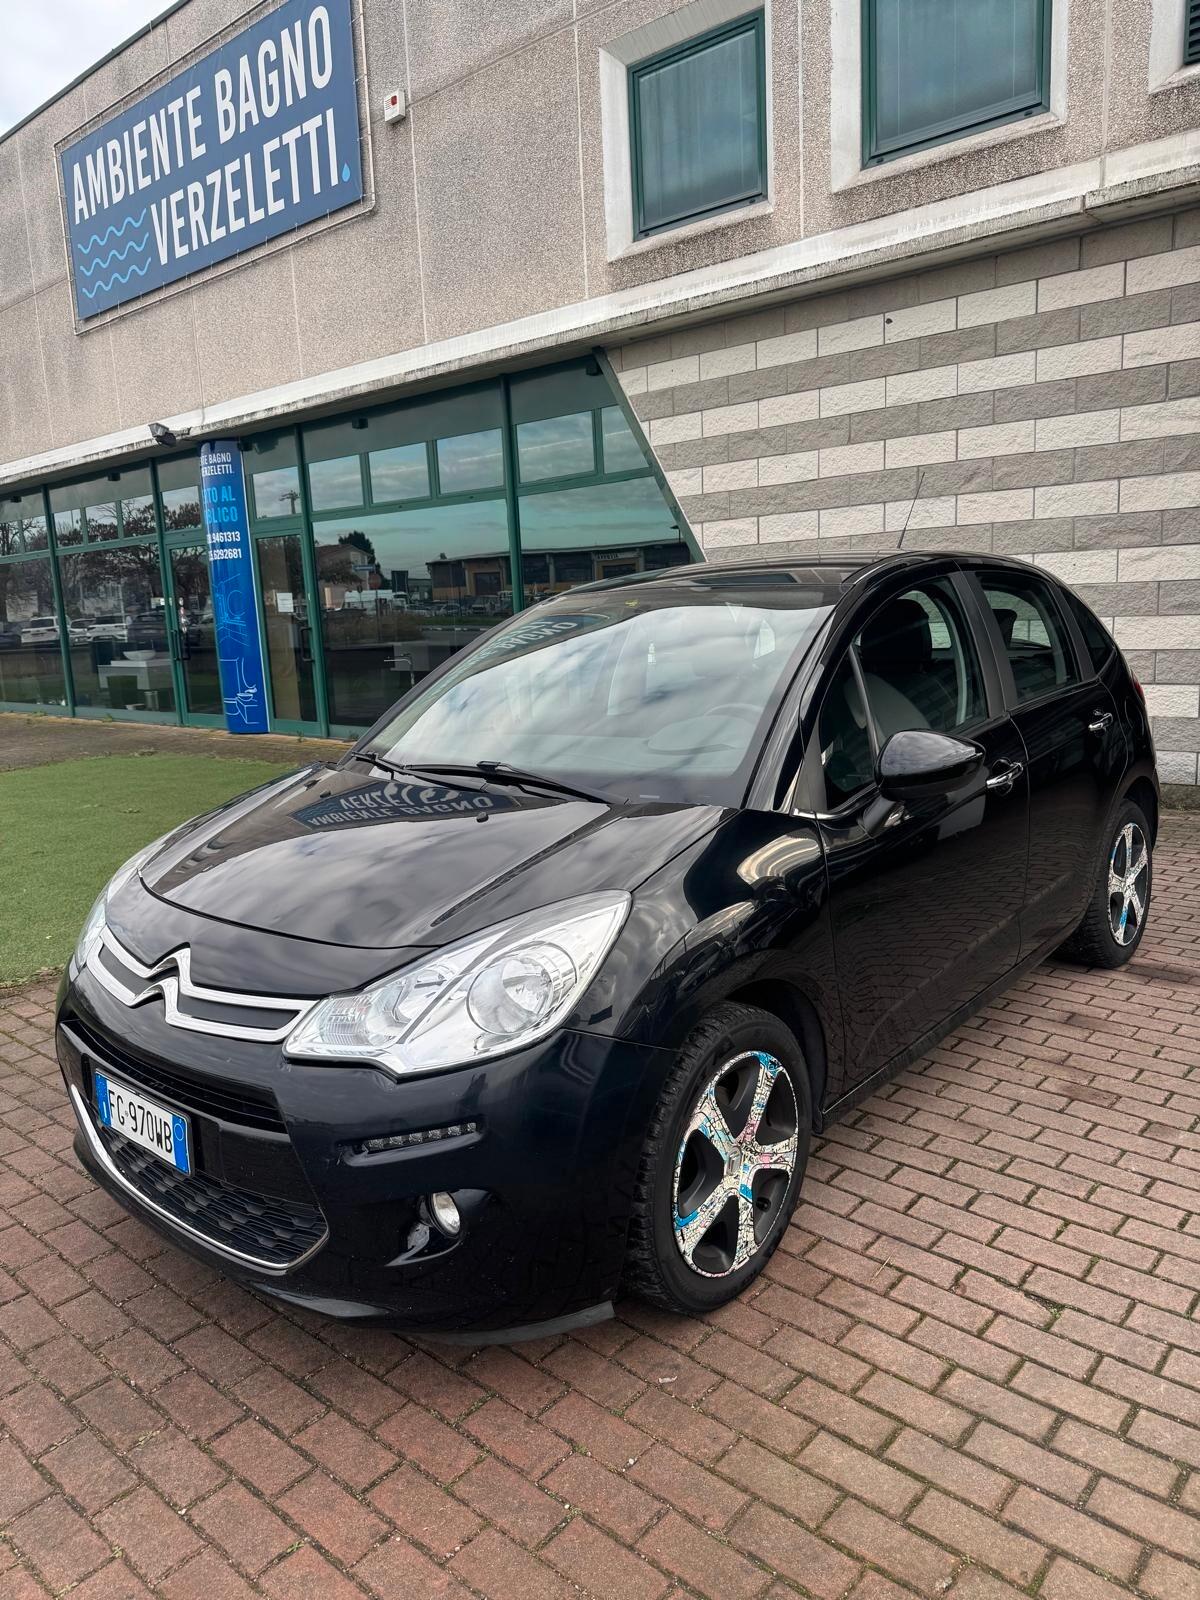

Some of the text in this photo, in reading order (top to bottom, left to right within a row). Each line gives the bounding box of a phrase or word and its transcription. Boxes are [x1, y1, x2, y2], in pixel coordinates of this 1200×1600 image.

[73, 5, 334, 225] AMBIENTE BAGNO
[208, 452, 232, 464] BAGNO
[221, 485, 236, 502] AL
